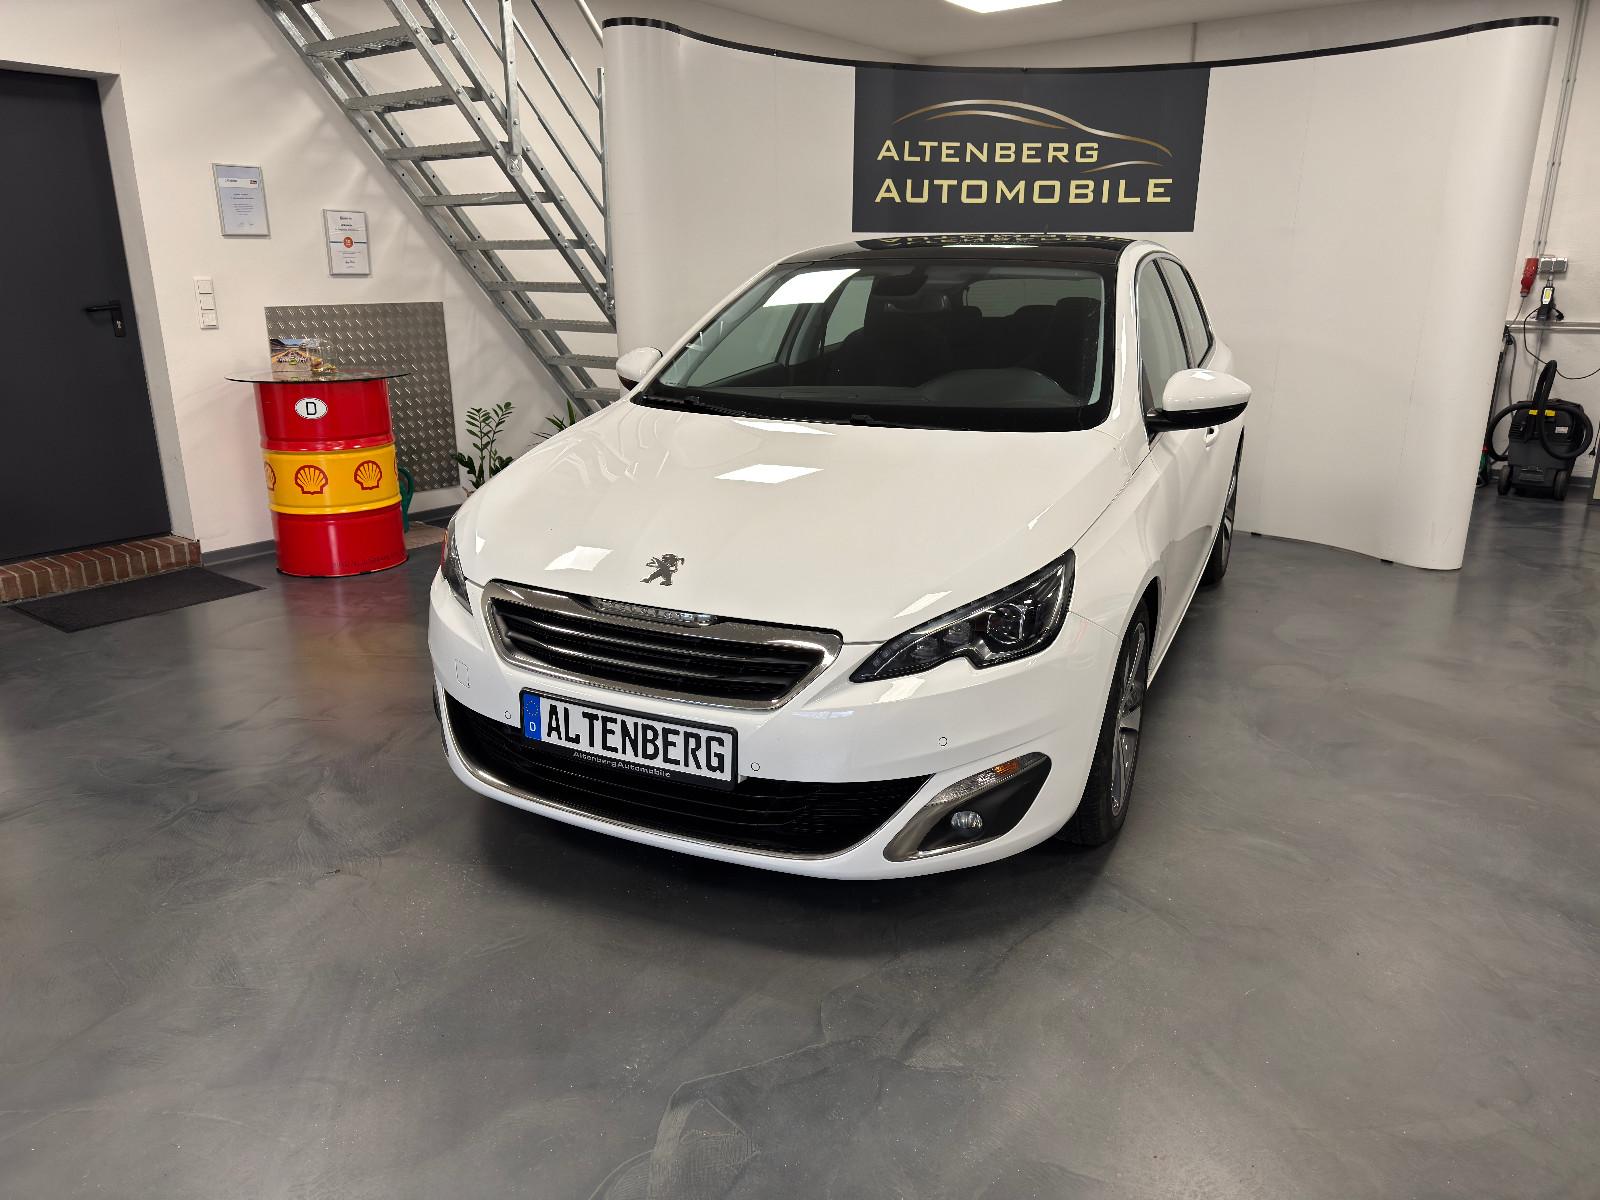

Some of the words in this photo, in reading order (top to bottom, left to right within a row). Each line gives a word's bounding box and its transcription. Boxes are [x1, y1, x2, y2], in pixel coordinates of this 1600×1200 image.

[877, 140, 1100, 164] ALTENBERG
[875, 178, 1173, 204] AUTOMOBILE
[305, 401, 317, 416] D
[529, 721, 536, 732] D
[546, 703, 725, 773] ALTENBERG
